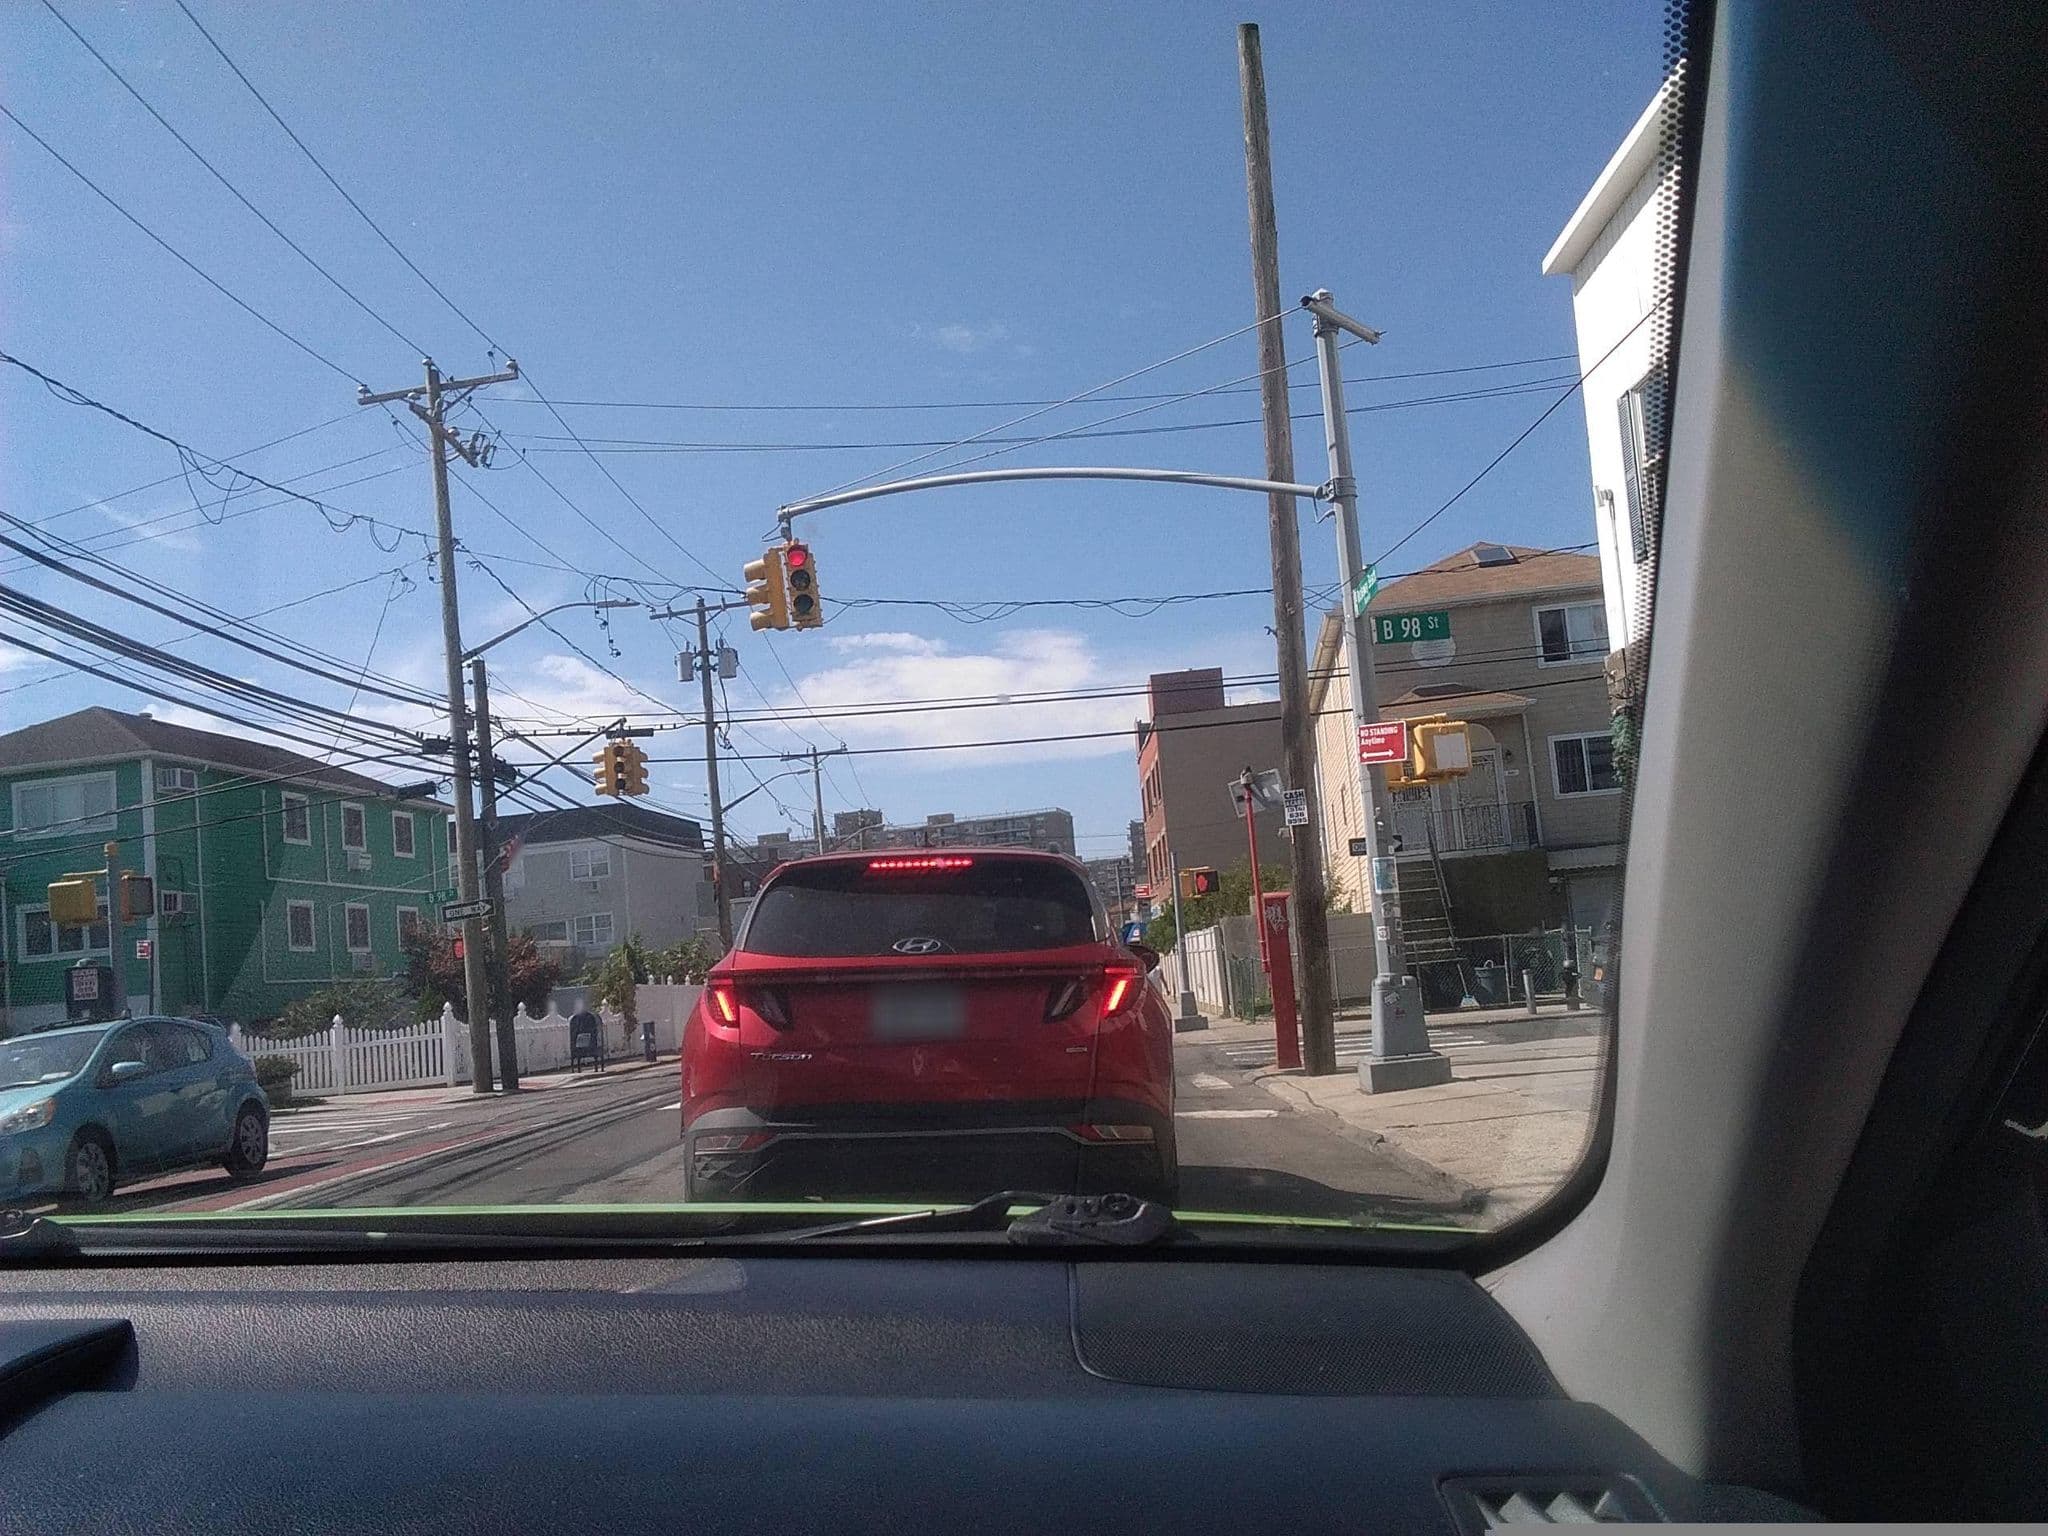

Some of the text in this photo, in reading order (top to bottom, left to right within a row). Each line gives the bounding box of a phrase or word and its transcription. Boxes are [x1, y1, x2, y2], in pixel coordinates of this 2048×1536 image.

[1383, 615, 1439, 640] B 98 St
[1360, 726, 1398, 737] NO STANDING
[1360, 737, 1385, 746] Anytime
[1284, 791, 1304, 800] CASH
[1354, 842, 1367, 850] ON
